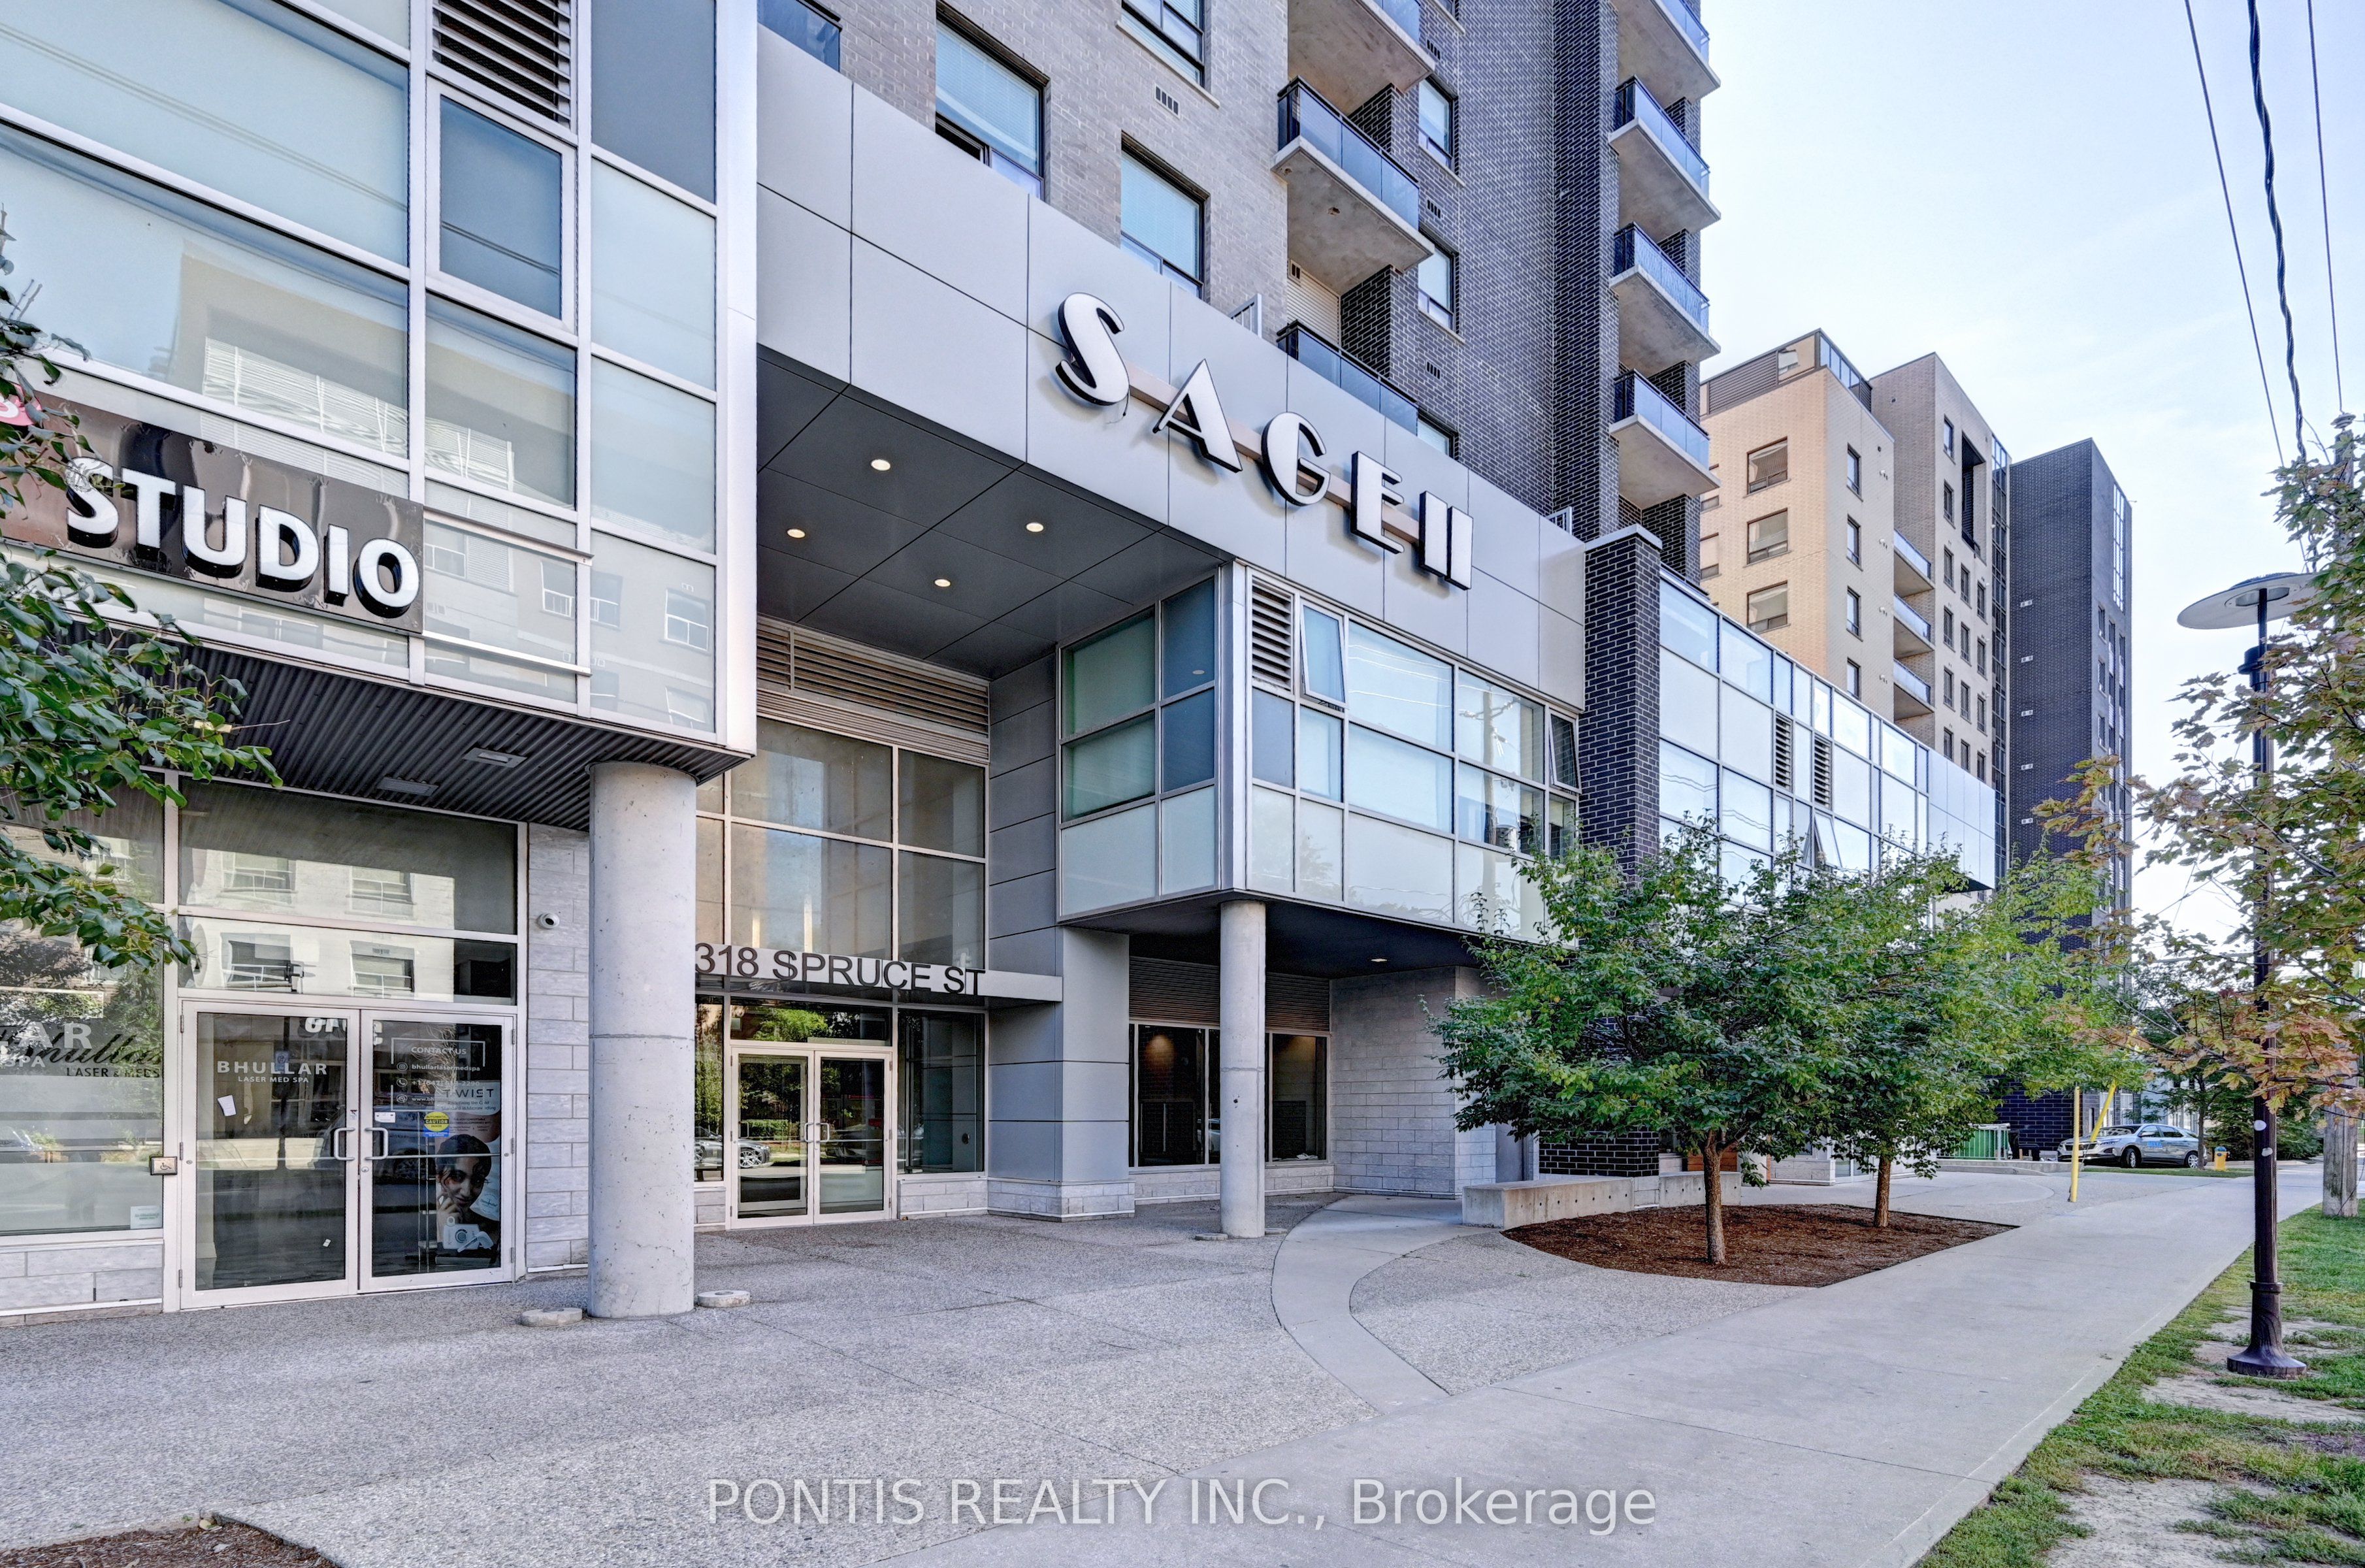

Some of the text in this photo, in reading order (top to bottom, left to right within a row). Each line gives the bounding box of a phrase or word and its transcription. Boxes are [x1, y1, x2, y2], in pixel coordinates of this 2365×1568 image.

[1055, 291, 1405, 555] SAGE
[66, 455, 419, 615] STUDIO
[694, 942, 986, 996] 318 SPRUCE ST
[217, 1060, 327, 1075] BHULLAR
[411, 1046, 453, 1055] CONTACT
[66, 1067, 109, 1077] LASER
